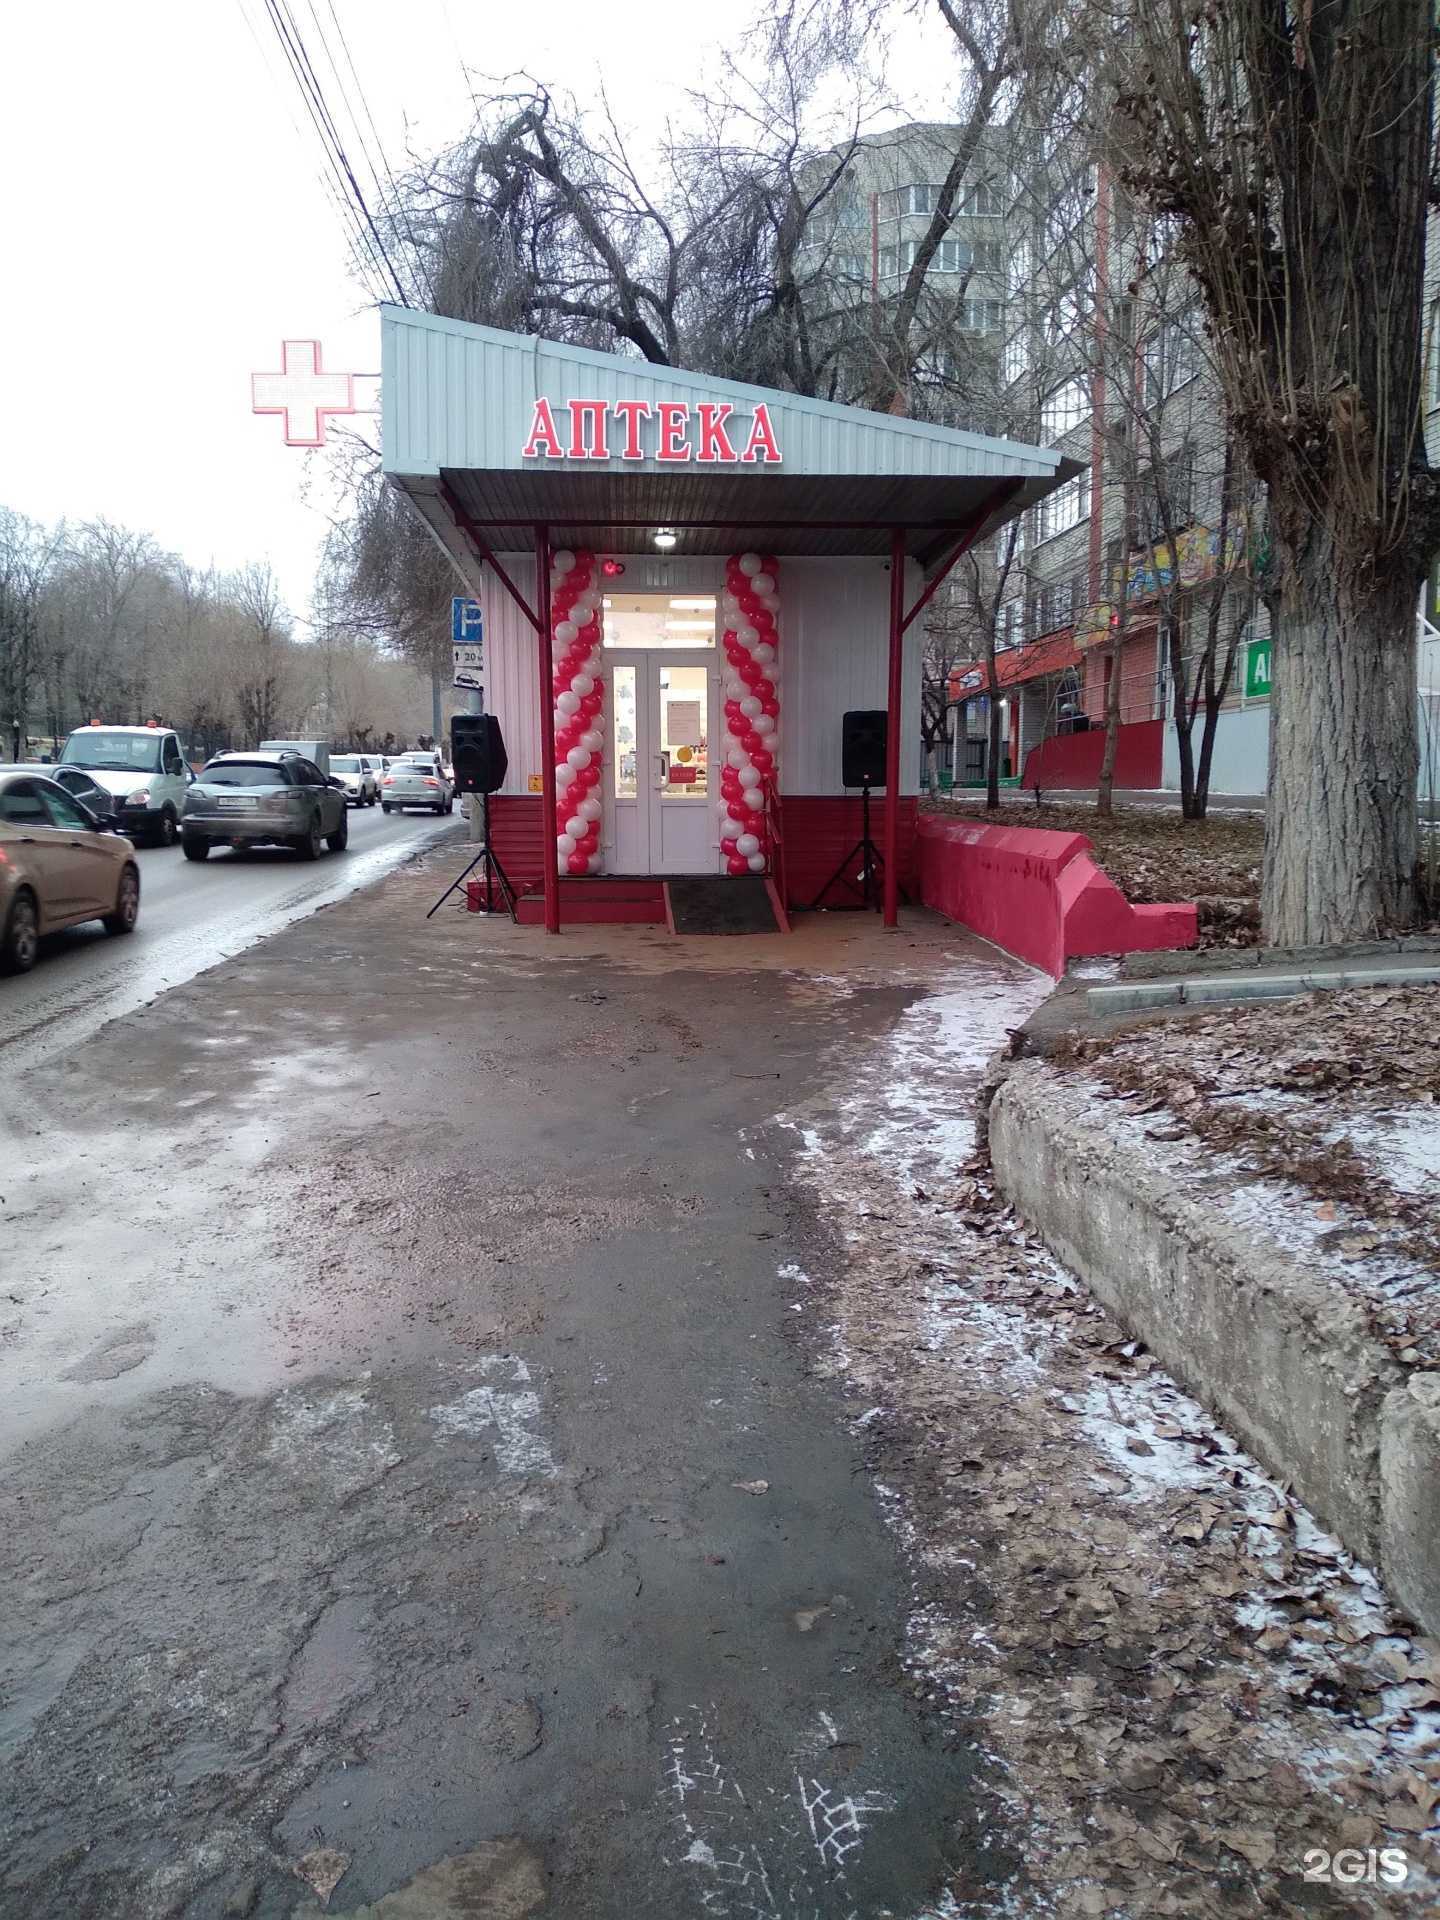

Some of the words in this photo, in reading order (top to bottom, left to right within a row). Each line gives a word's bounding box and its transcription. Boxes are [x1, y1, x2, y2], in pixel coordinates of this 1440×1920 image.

[522, 397, 782, 462] АПТЕКА
[465, 652, 476, 661] 20
[1254, 651, 1272, 683] А
